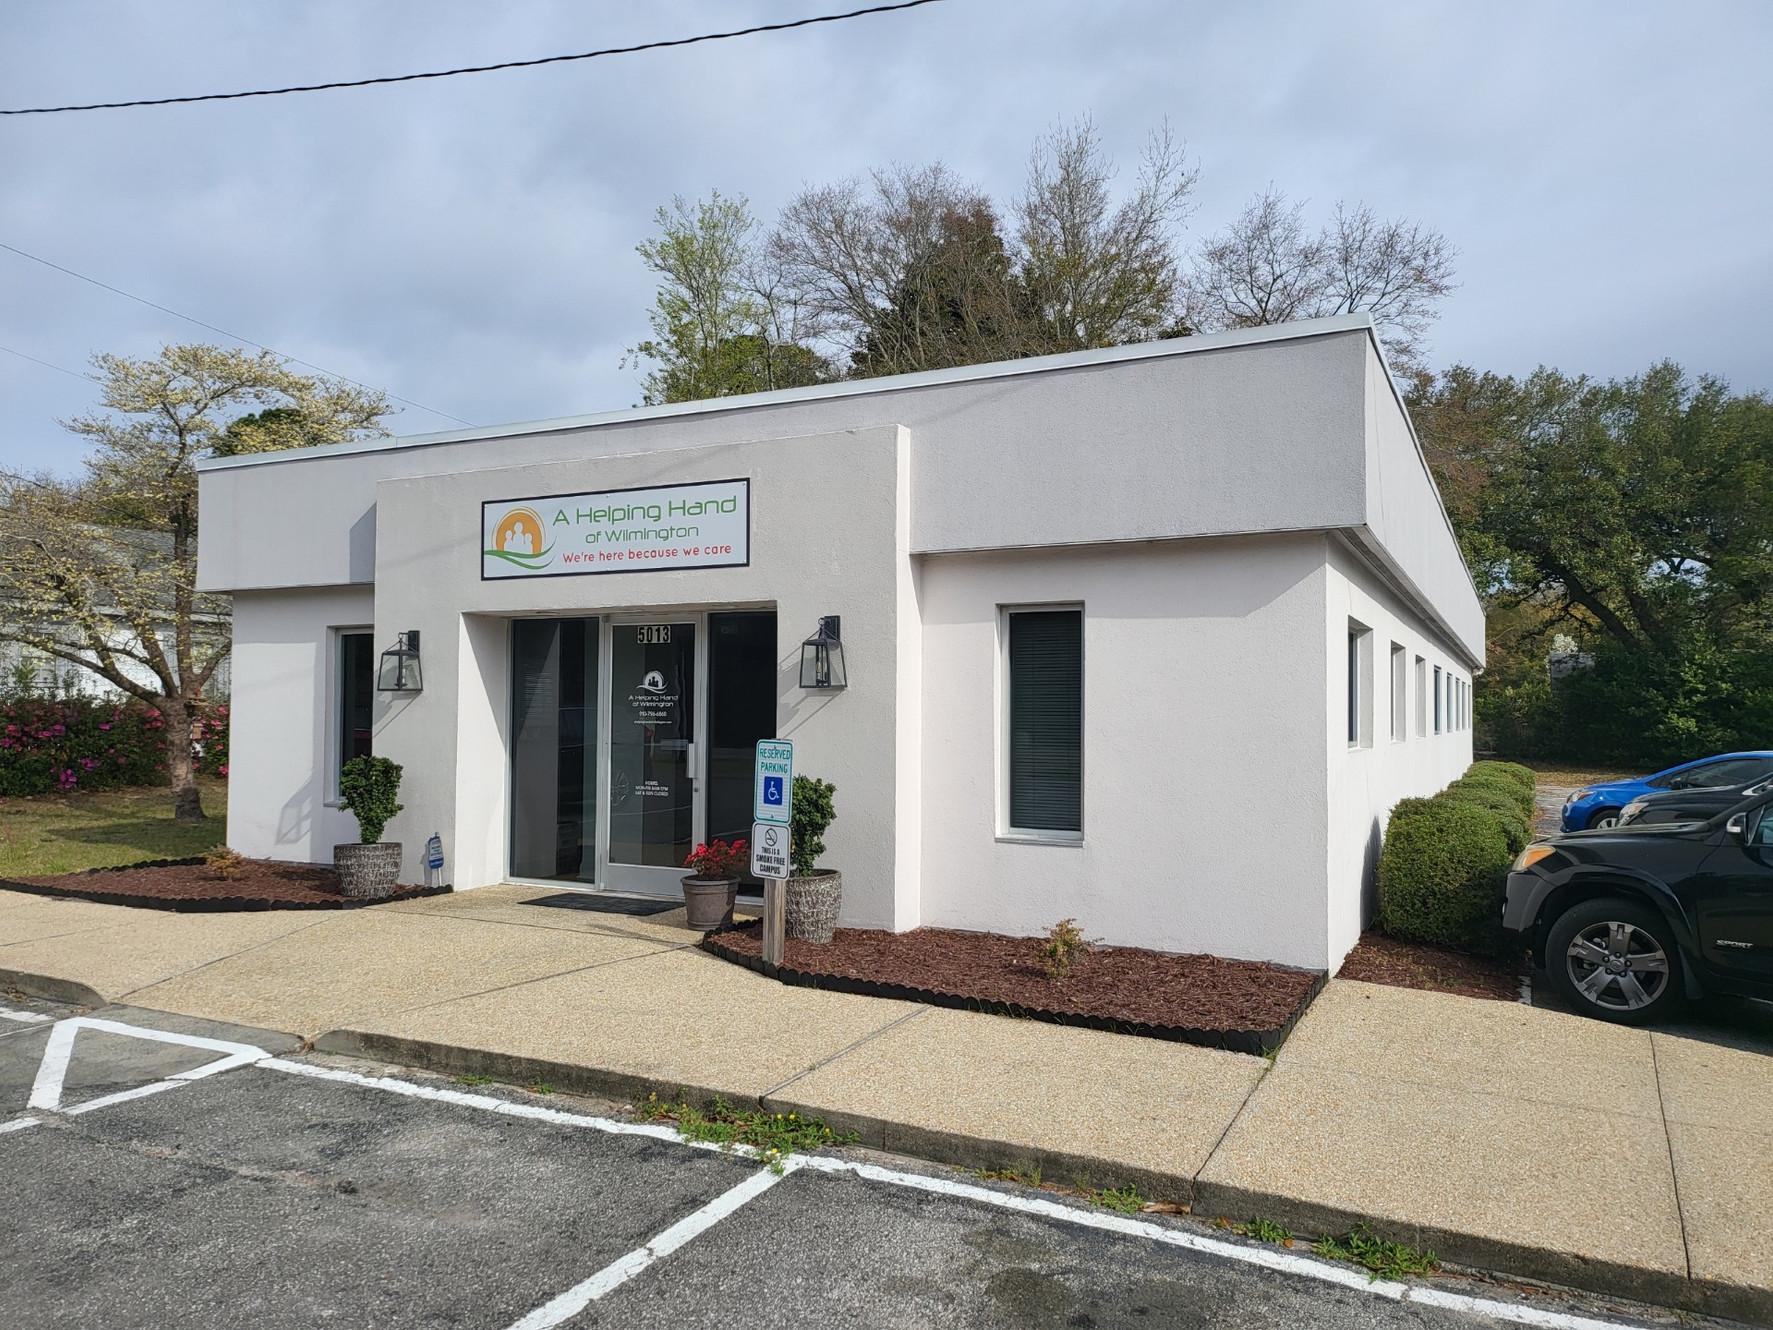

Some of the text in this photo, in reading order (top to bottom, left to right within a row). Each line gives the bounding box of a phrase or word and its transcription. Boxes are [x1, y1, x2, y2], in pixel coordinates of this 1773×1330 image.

[552, 495, 737, 526] A Helping Hand
[585, 525, 699, 544] of Wilmington
[563, 545, 732, 563] We're here because we care
[638, 626, 669, 643] 5013
[759, 747, 791, 760] RESERVED
[760, 762, 788, 774] PARKING
[761, 846, 780, 856] THIS IS A
[755, 854, 785, 866] SMOKE FREE
[759, 863, 781, 875] CAMPUS
